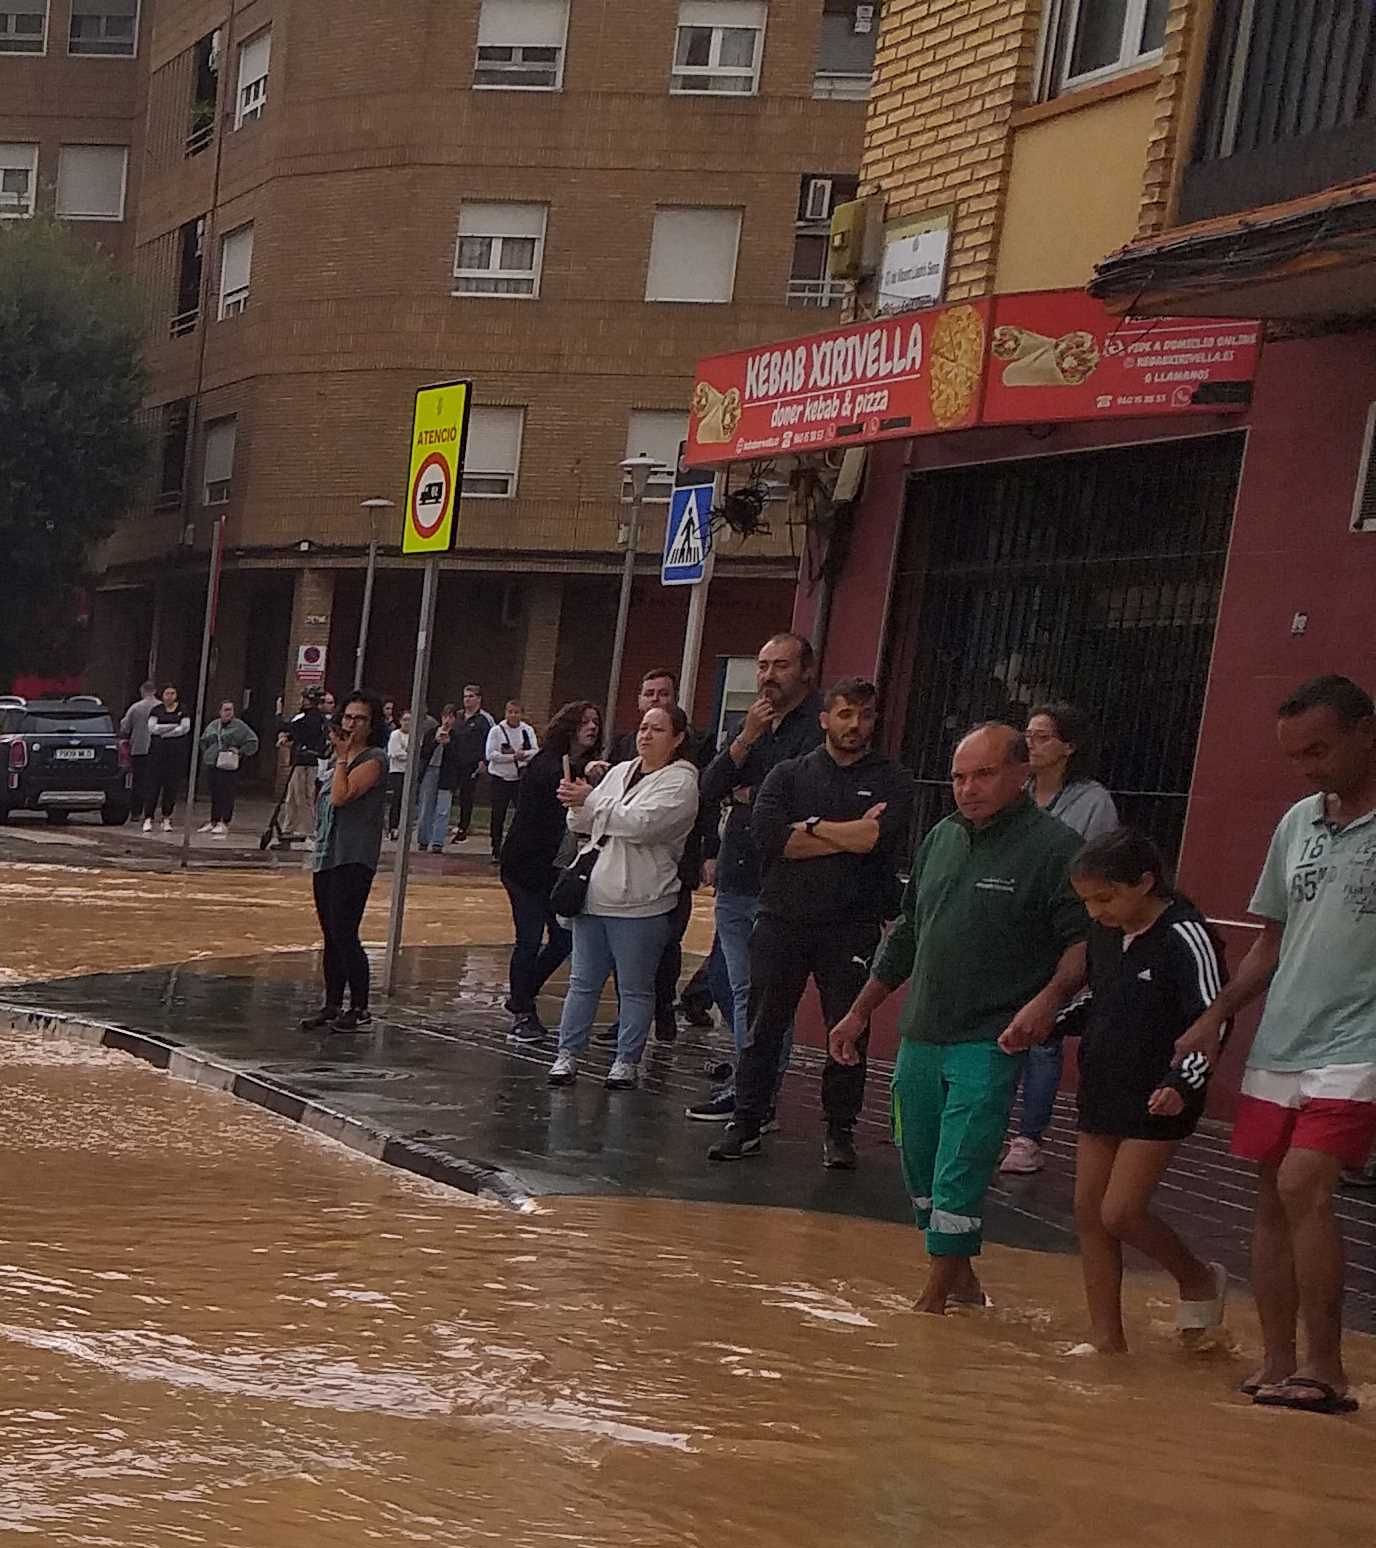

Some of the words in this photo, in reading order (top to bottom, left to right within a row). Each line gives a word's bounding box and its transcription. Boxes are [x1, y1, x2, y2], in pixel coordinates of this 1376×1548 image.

[744, 346, 807, 400] KEBAB
[808, 321, 922, 389] XIRIVELLA
[770, 401, 804, 428] doner
[803, 396, 840, 421] kebab
[841, 395, 852, 417] &
[852, 389, 889, 424] pizza
[417, 424, 457, 446] ATENCIÓ
